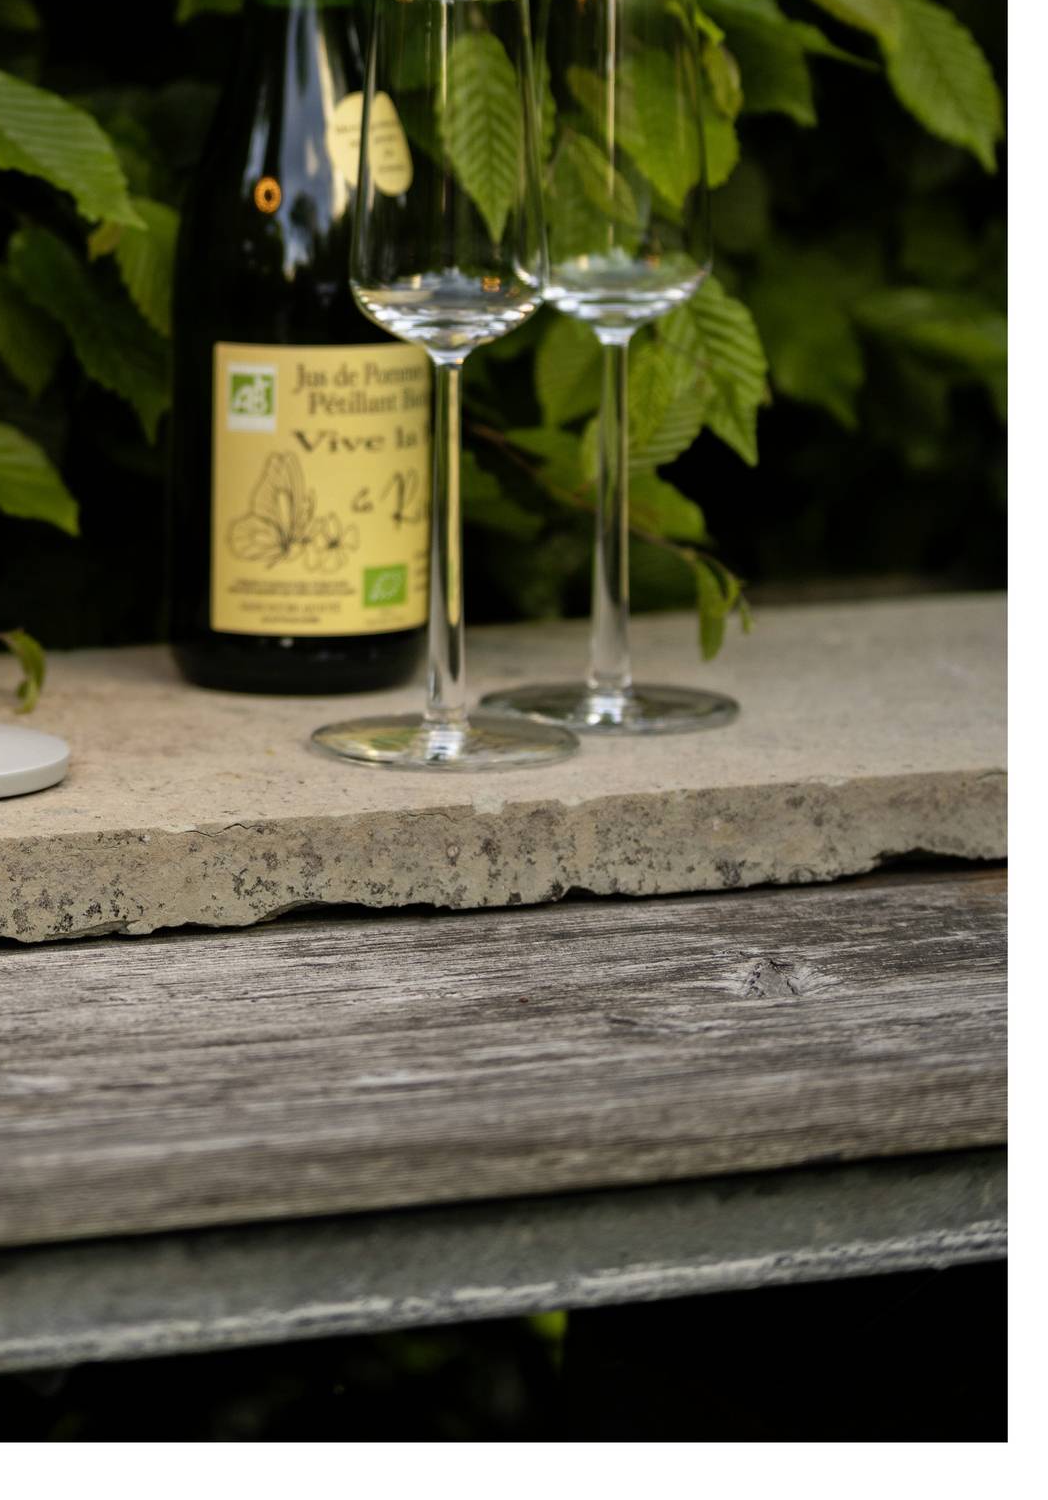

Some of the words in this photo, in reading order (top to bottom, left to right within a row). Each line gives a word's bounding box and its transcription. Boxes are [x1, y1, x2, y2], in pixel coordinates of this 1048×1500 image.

[292, 362, 328, 394] Jus
[332, 362, 357, 388] de
[307, 389, 397, 416] Pétillant
[291, 428, 386, 453] Vive
[394, 424, 418, 451] la
